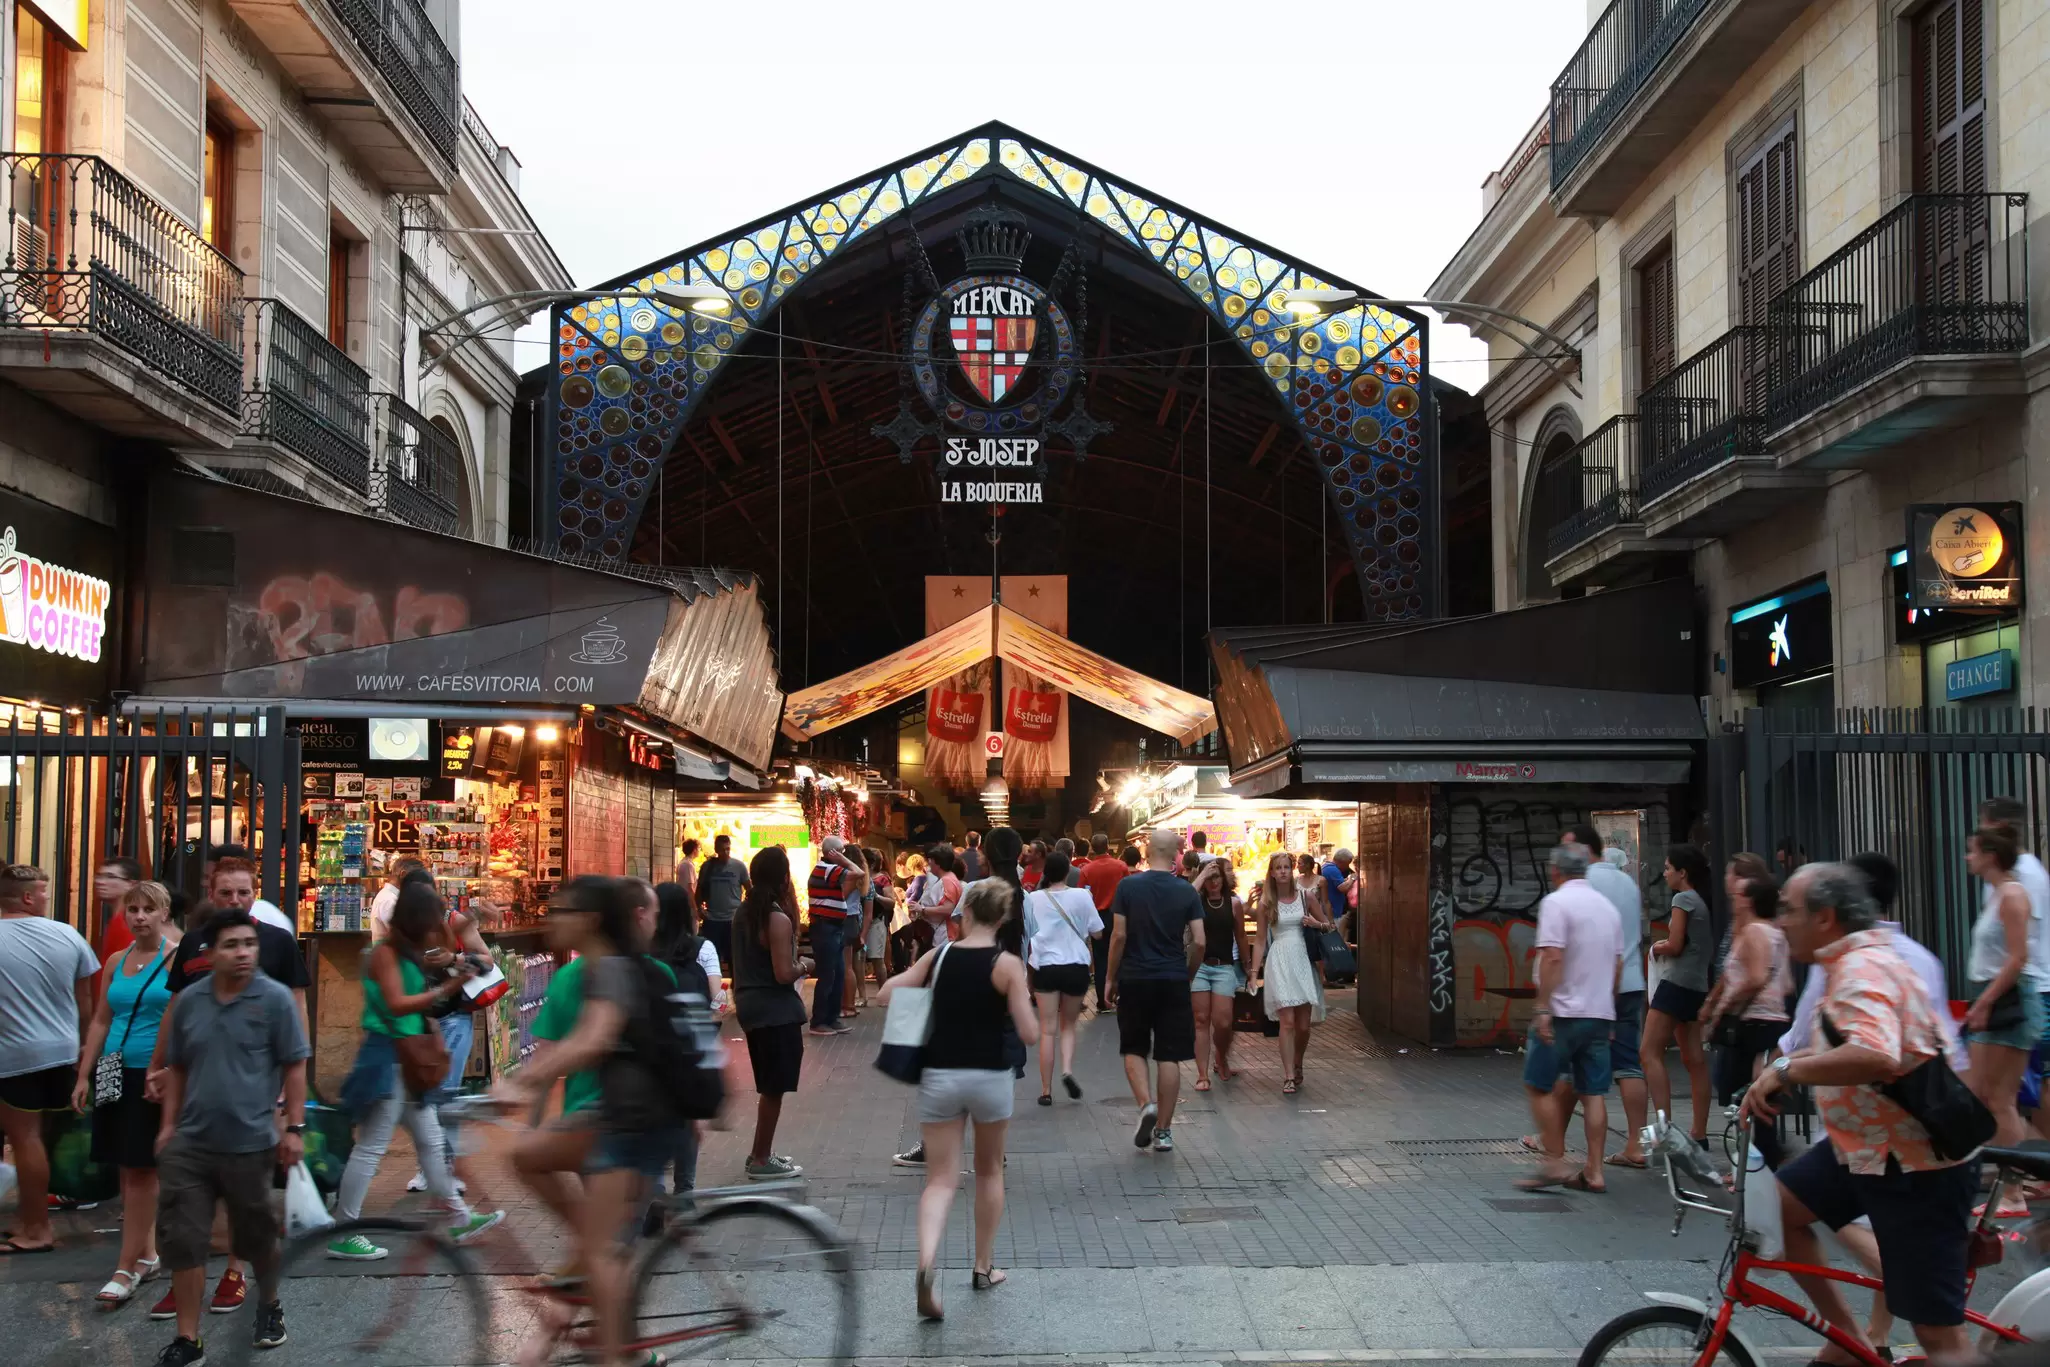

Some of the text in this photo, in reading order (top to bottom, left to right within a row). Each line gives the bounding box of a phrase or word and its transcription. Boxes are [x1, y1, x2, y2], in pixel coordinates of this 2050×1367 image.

[953, 286, 1035, 315] MERCAT
[967, 438, 1040, 466] JOSEP
[941, 482, 1043, 503] LA BOQUERIA
[1935, 539, 1961, 549] Caixa
[30, 563, 107, 619] DUNKIN'
[1949, 585, 2009, 600] ServiRed
[29, 604, 100, 657] COFFEE
[1948, 660, 2000, 691] CHANGE
[936, 707, 975, 724] Estrella
[1014, 707, 1053, 724] Estrella
[1305, 725, 1362, 736] JABUGO
[302, 735, 355, 748] PRESSO
[990, 738, 998, 751] 6
[443, 749, 470, 760] BREAKFAST
[1456, 761, 1518, 776] Marcos
